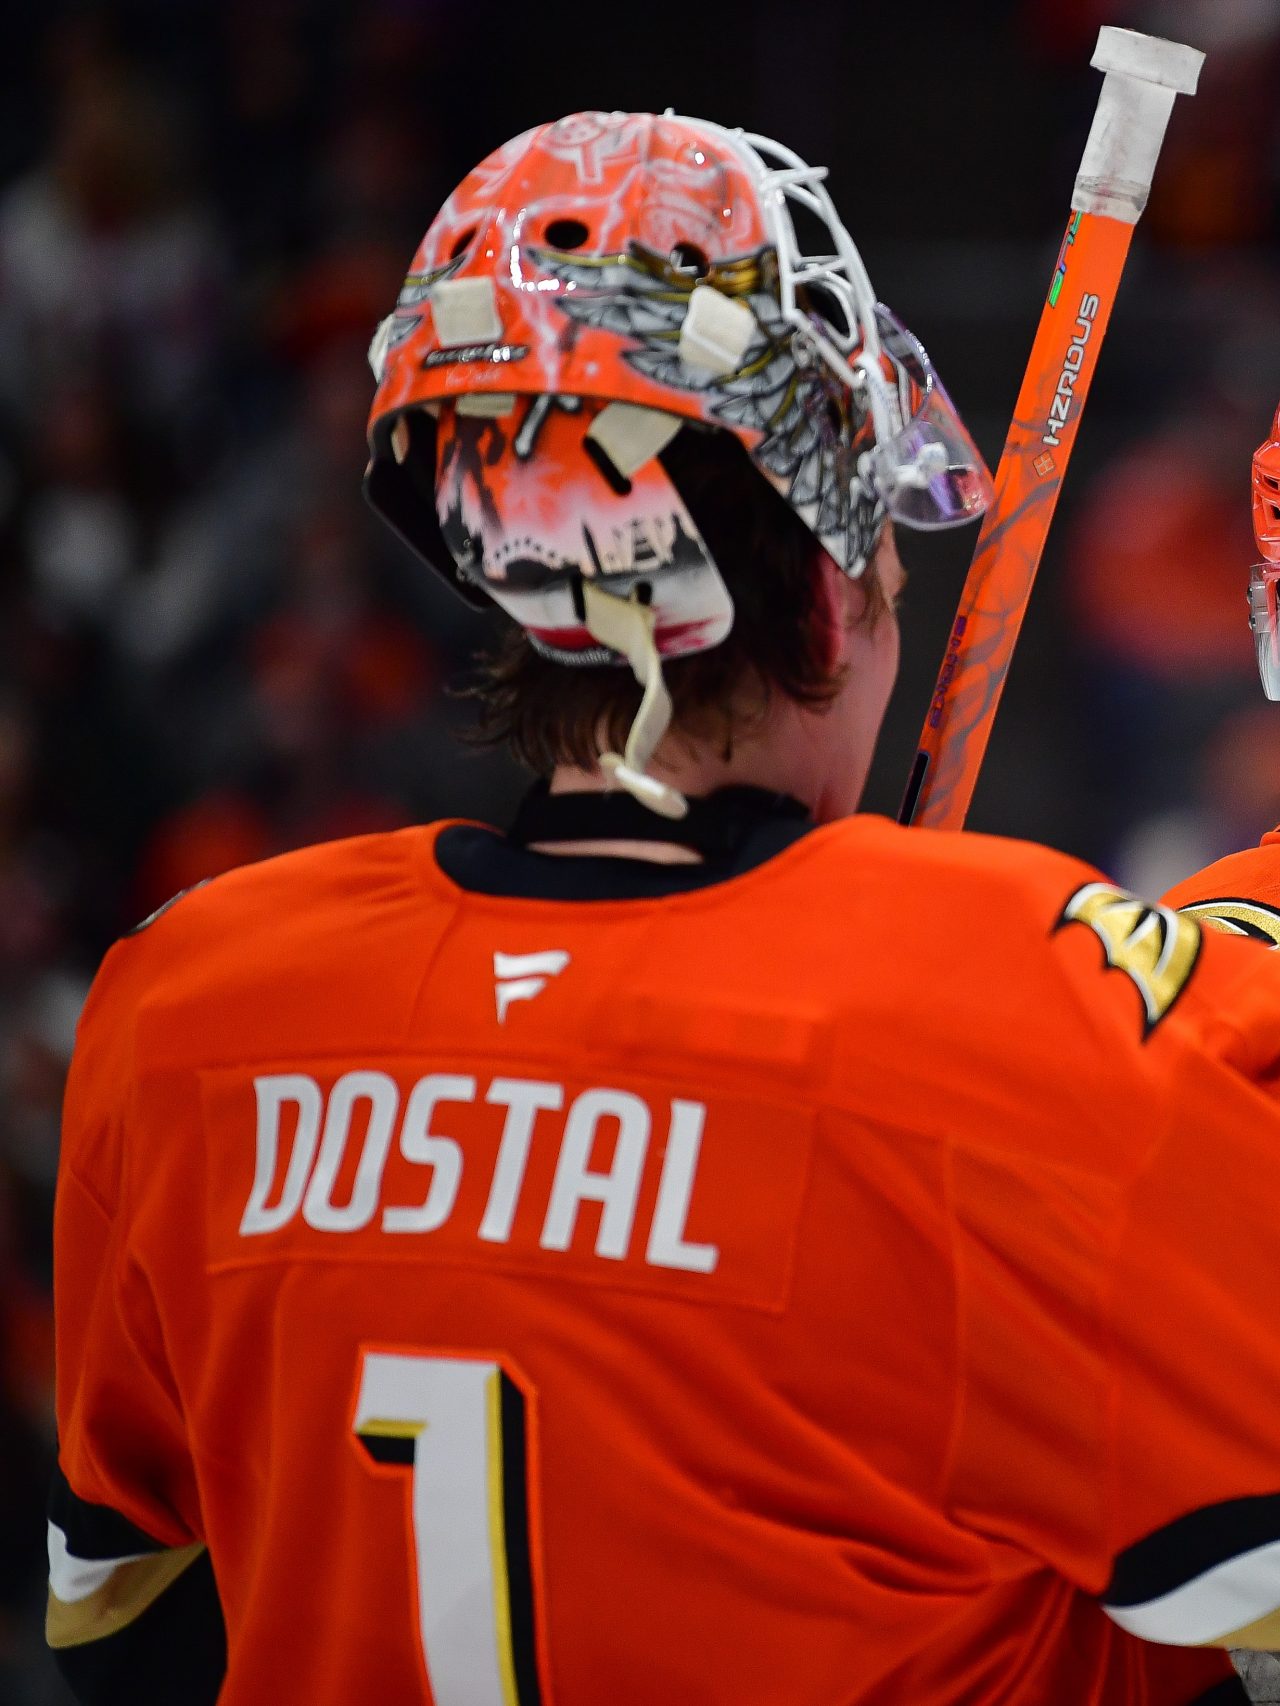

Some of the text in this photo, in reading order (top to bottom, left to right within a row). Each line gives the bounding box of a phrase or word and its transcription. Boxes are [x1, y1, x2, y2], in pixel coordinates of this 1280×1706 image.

[1042, 291, 1100, 447] HZRDUS
[239, 1070, 719, 1273] DOSTAL
[354, 1352, 543, 1706] 1
